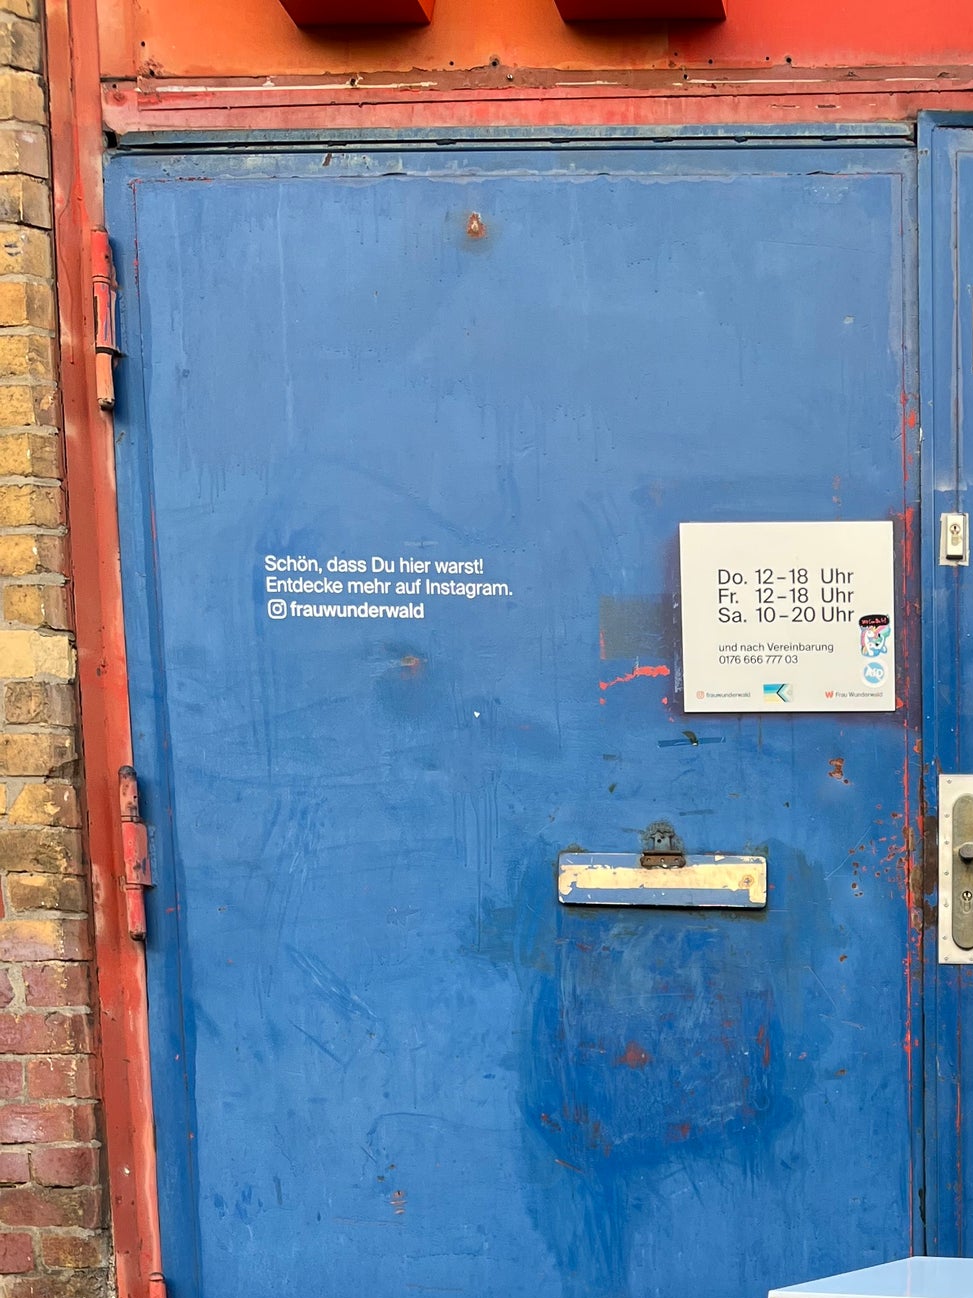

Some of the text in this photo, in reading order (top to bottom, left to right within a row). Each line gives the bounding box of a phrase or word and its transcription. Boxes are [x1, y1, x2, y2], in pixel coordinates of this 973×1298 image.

[265, 555, 483, 574] Schön, dass Du hier warst!
[718, 569, 747, 585] Do.
[821, 568, 854, 584] Uhr
[267, 577, 512, 598] Entdecke mehr auf Instagram.
[719, 588, 738, 604] Fr.
[821, 587, 854, 603] Uhr
[290, 601, 424, 618] frauwunderwald
[718, 607, 747, 623] Sa.
[822, 606, 854, 622] Uhr
[718, 642, 834, 654] und nach Vereinbarung
[719, 655, 798, 664] 0176 666 777 03
